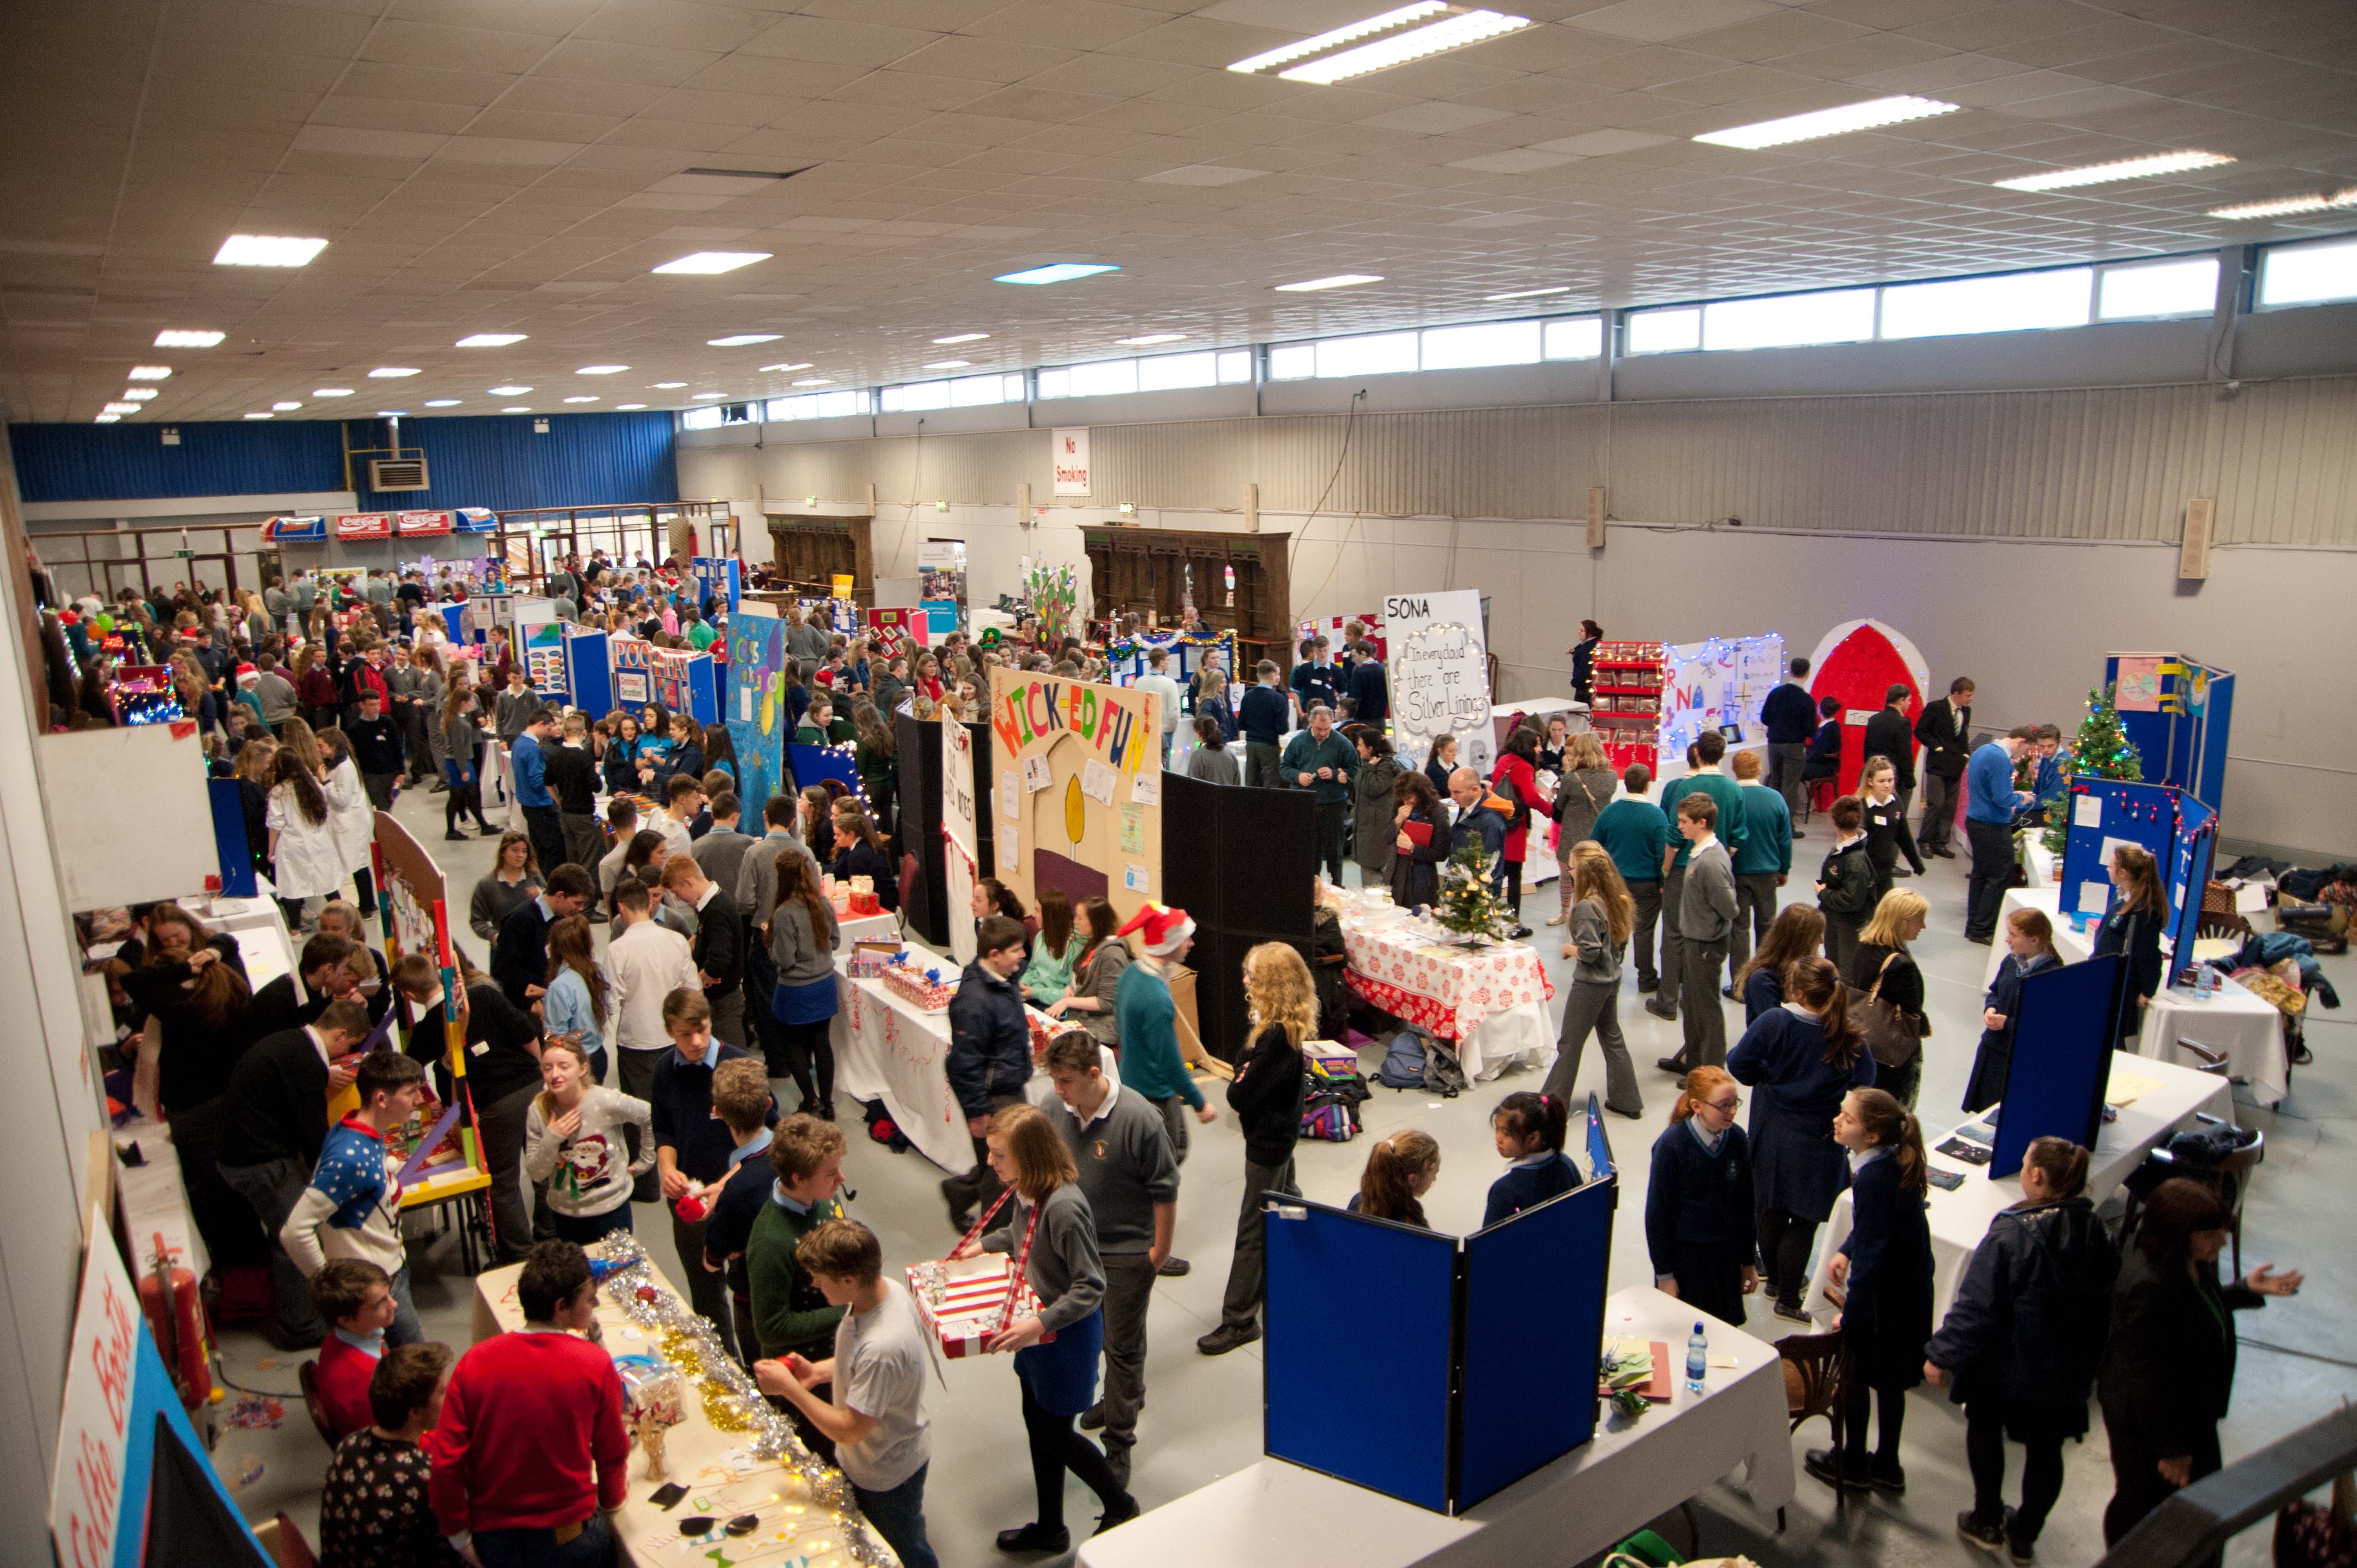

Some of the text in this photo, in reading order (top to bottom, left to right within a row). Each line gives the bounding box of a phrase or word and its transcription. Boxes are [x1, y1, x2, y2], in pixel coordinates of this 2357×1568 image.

[1066, 436, 1076, 454] No
[1056, 465, 1087, 487] Smoking
[1388, 599, 1430, 619] SONA
[1408, 668, 1460, 690] there are
[1409, 691, 1445, 721] Silver
[994, 682, 1097, 759] WICK-ED
[1095, 698, 1149, 782] FUN
